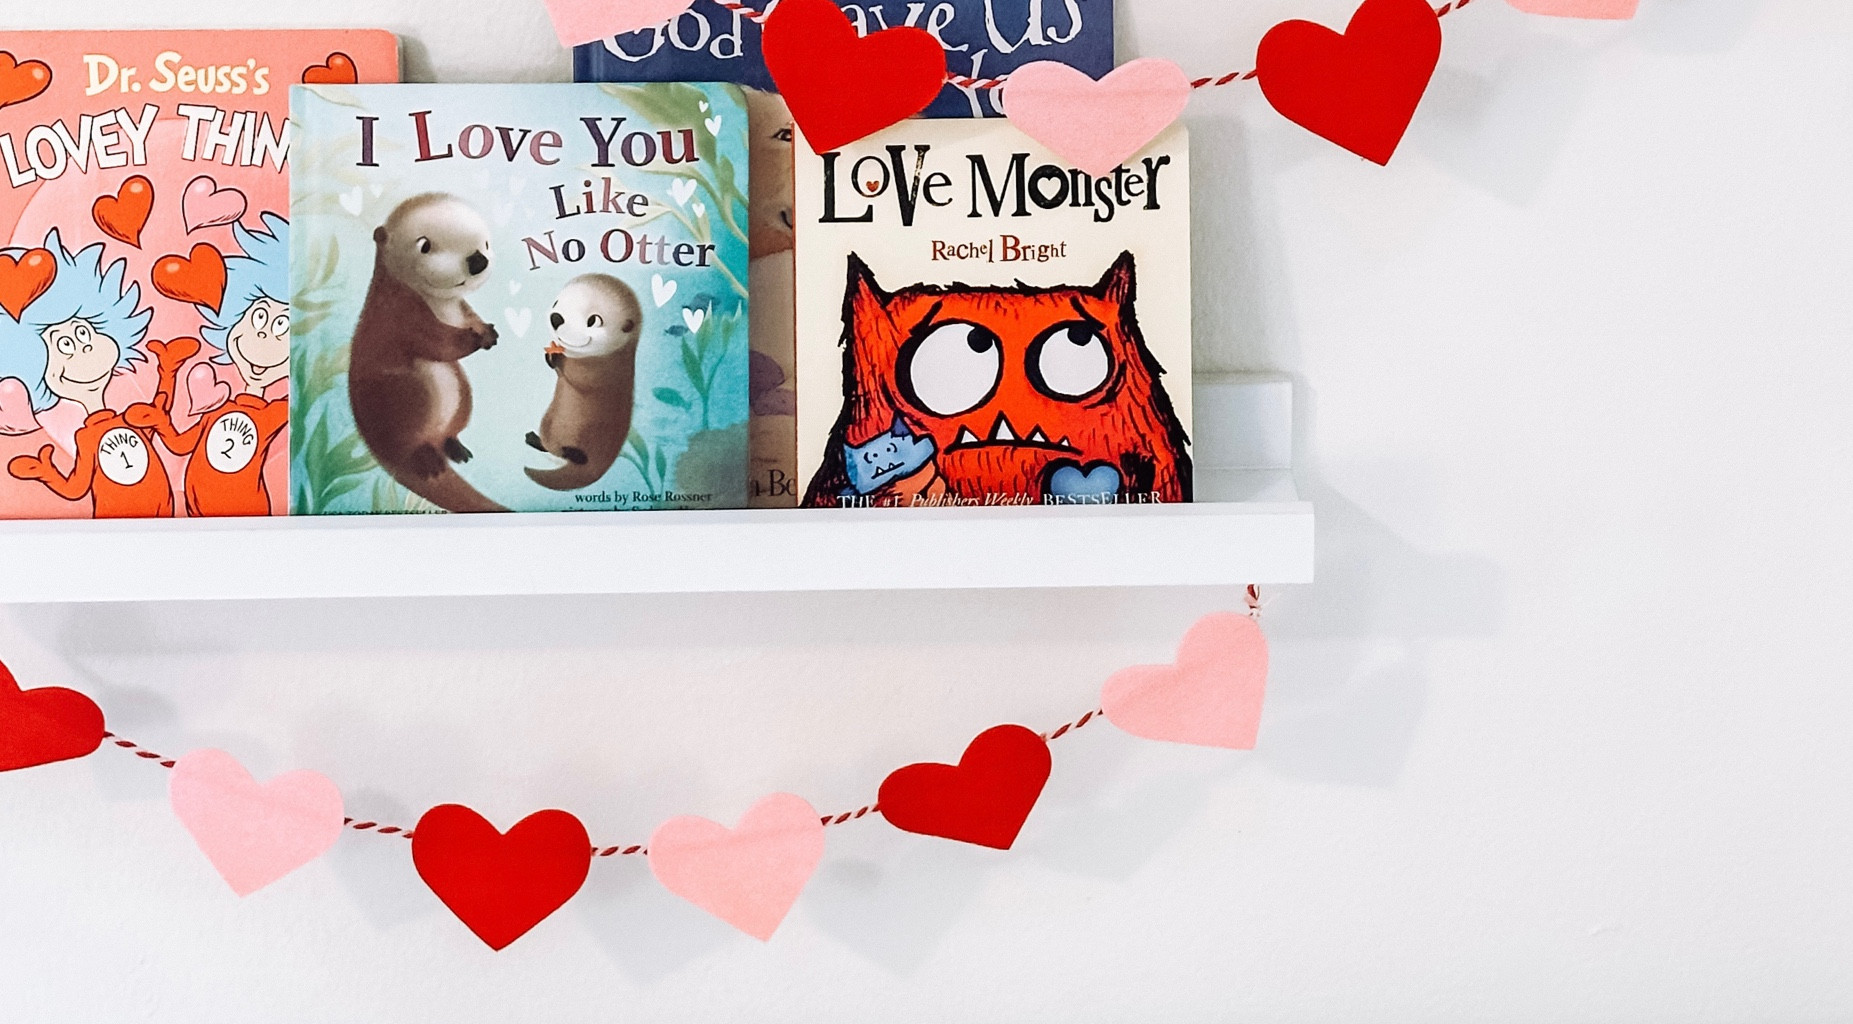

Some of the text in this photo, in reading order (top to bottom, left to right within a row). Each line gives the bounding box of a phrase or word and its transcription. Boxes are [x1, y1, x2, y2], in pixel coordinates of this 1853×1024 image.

[83, 51, 270, 96] Dr. Seuss's
[0, 103, 160, 188] LOVEY
[356, 110, 700, 168] I Love You
[549, 177, 649, 220] Like
[966, 152, 1171, 223] Monster
[521, 227, 716, 271] No Otter
[931, 234, 1067, 263] Rachel Bright
[100, 433, 139, 456] THING
[220, 417, 255, 446] THING
[119, 451, 134, 469] 1
[220, 438, 235, 459] 2
[575, 490, 713, 506] words by Rose Rossner
[836, 495, 877, 508] THE
[910, 493, 981, 507] Publishers
[984, 492, 1034, 506] Weekly
[1043, 491, 1162, 505] BESTSELLER
